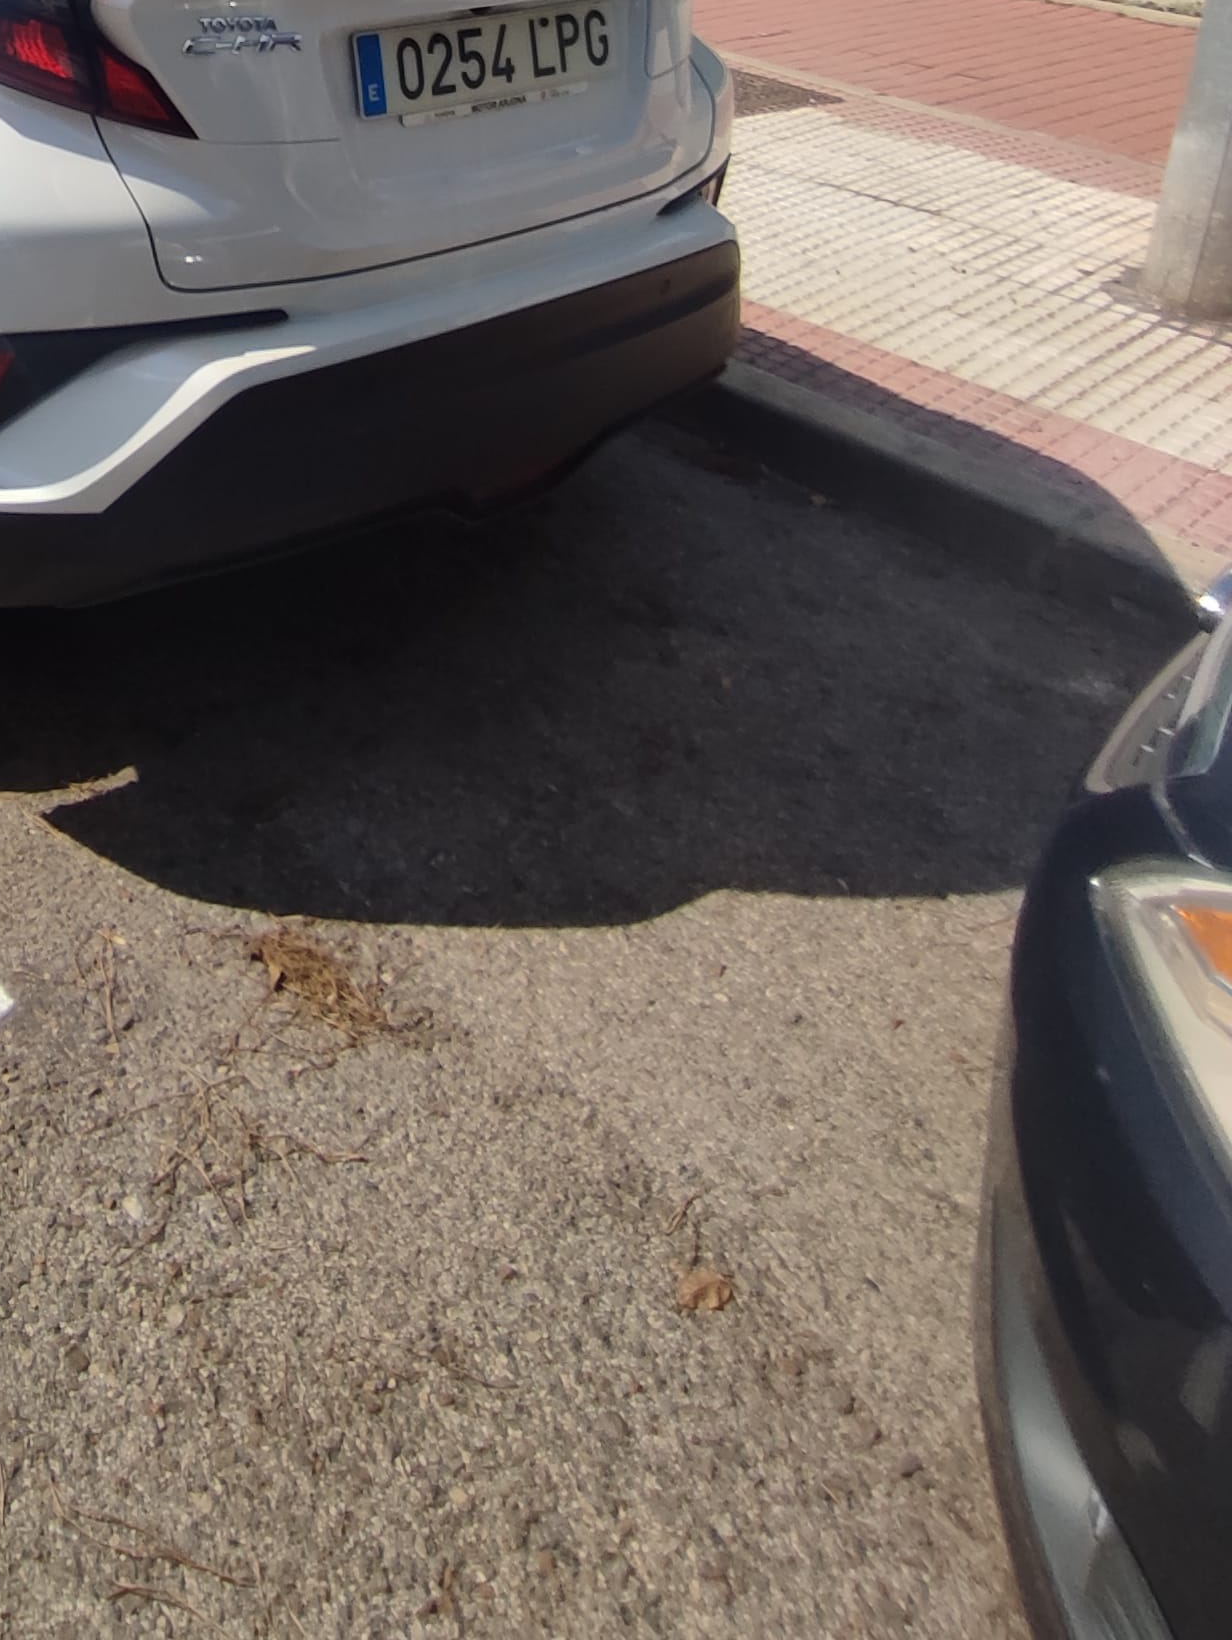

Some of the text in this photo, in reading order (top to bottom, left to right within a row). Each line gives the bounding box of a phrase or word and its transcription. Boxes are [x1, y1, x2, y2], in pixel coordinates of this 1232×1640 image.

[199, 16, 278, 33] TOYOTA
[182, 32, 303, 55] C-HR
[396, 9, 609, 101] 0254 LPG
[368, 83, 380, 102] E
